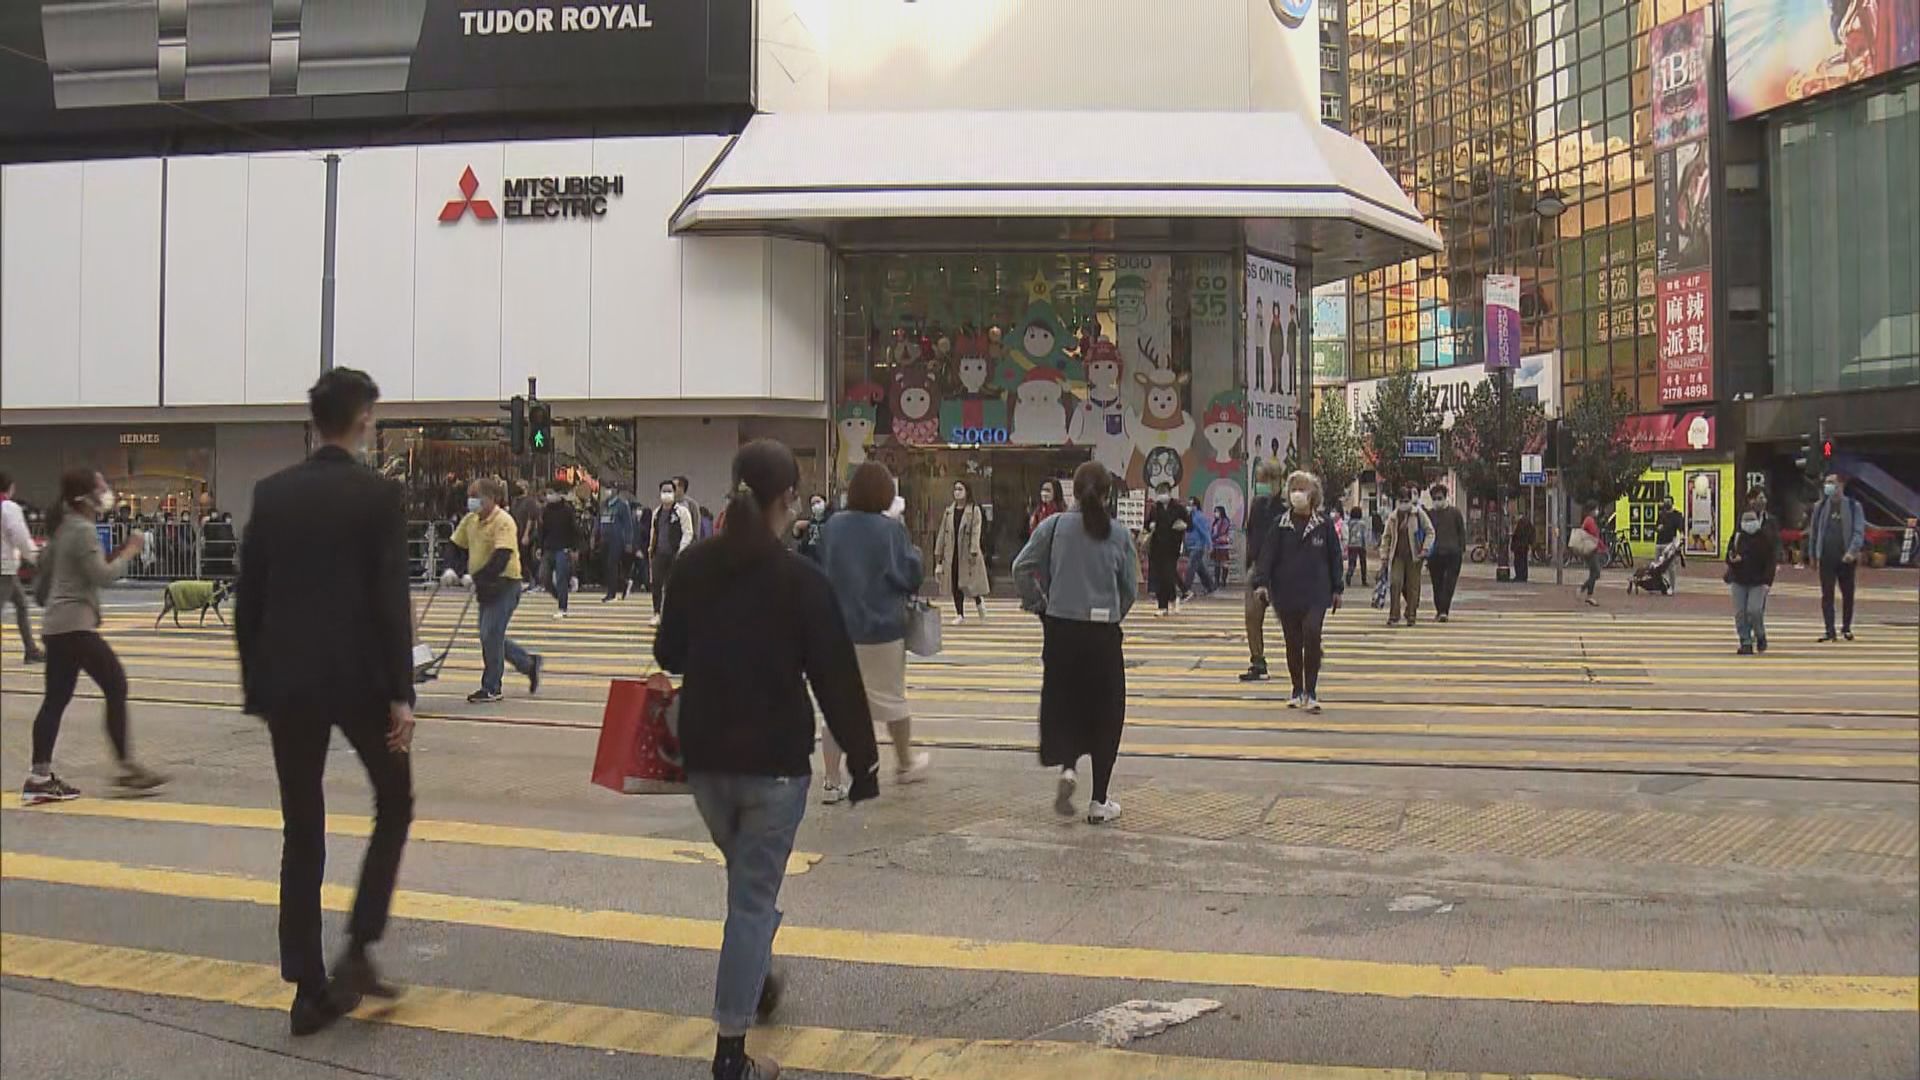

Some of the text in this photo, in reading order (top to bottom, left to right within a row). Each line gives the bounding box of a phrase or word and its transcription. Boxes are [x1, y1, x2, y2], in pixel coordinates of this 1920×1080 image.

[460, 4, 652, 35] TUDOR ROYAL
[504, 175, 623, 198] MITSUBISHI
[504, 197, 607, 220] ELECTRIC
[1260, 265, 1273, 283] ON
[1274, 270, 1292, 287] THE
[1666, 291, 1704, 325] 麻辣
[1666, 324, 1705, 358] 派對
[1426, 376, 1470, 413] izzue
[1663, 384, 1708, 400] 2178 4898
[1256, 402, 1274, 419] THE
[953, 428, 1008, 443] SOGO
